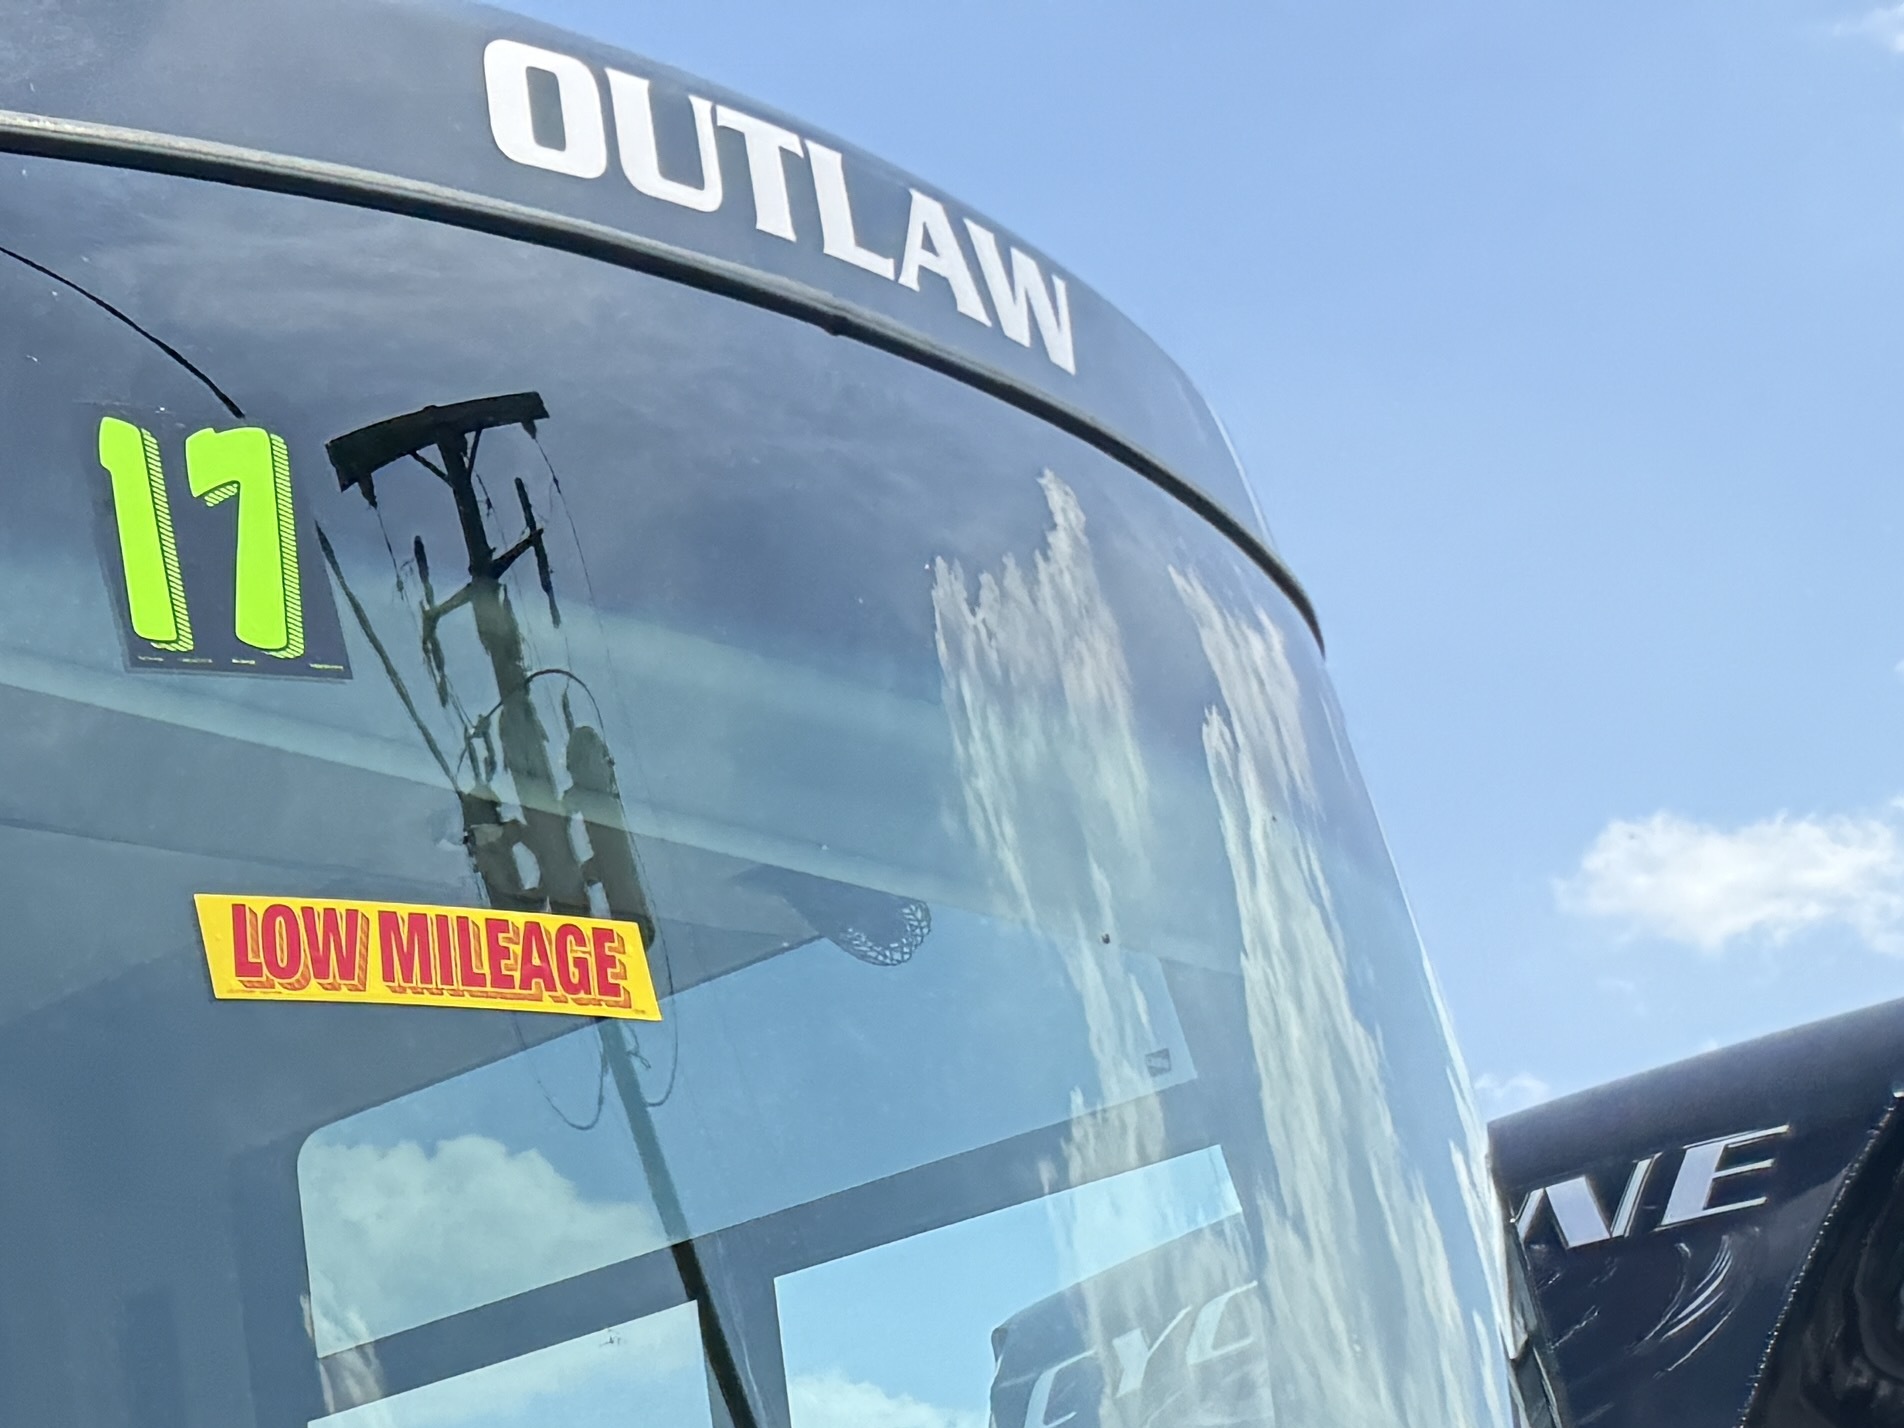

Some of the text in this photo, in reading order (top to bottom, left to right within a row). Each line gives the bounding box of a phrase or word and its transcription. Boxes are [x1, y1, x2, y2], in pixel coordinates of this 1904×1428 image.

[483, 39, 1076, 376] OUTLAW
[98, 416, 305, 659] 17
[231, 902, 633, 1010] LOW MILEAGE
[1510, 1123, 1792, 1249] NE
